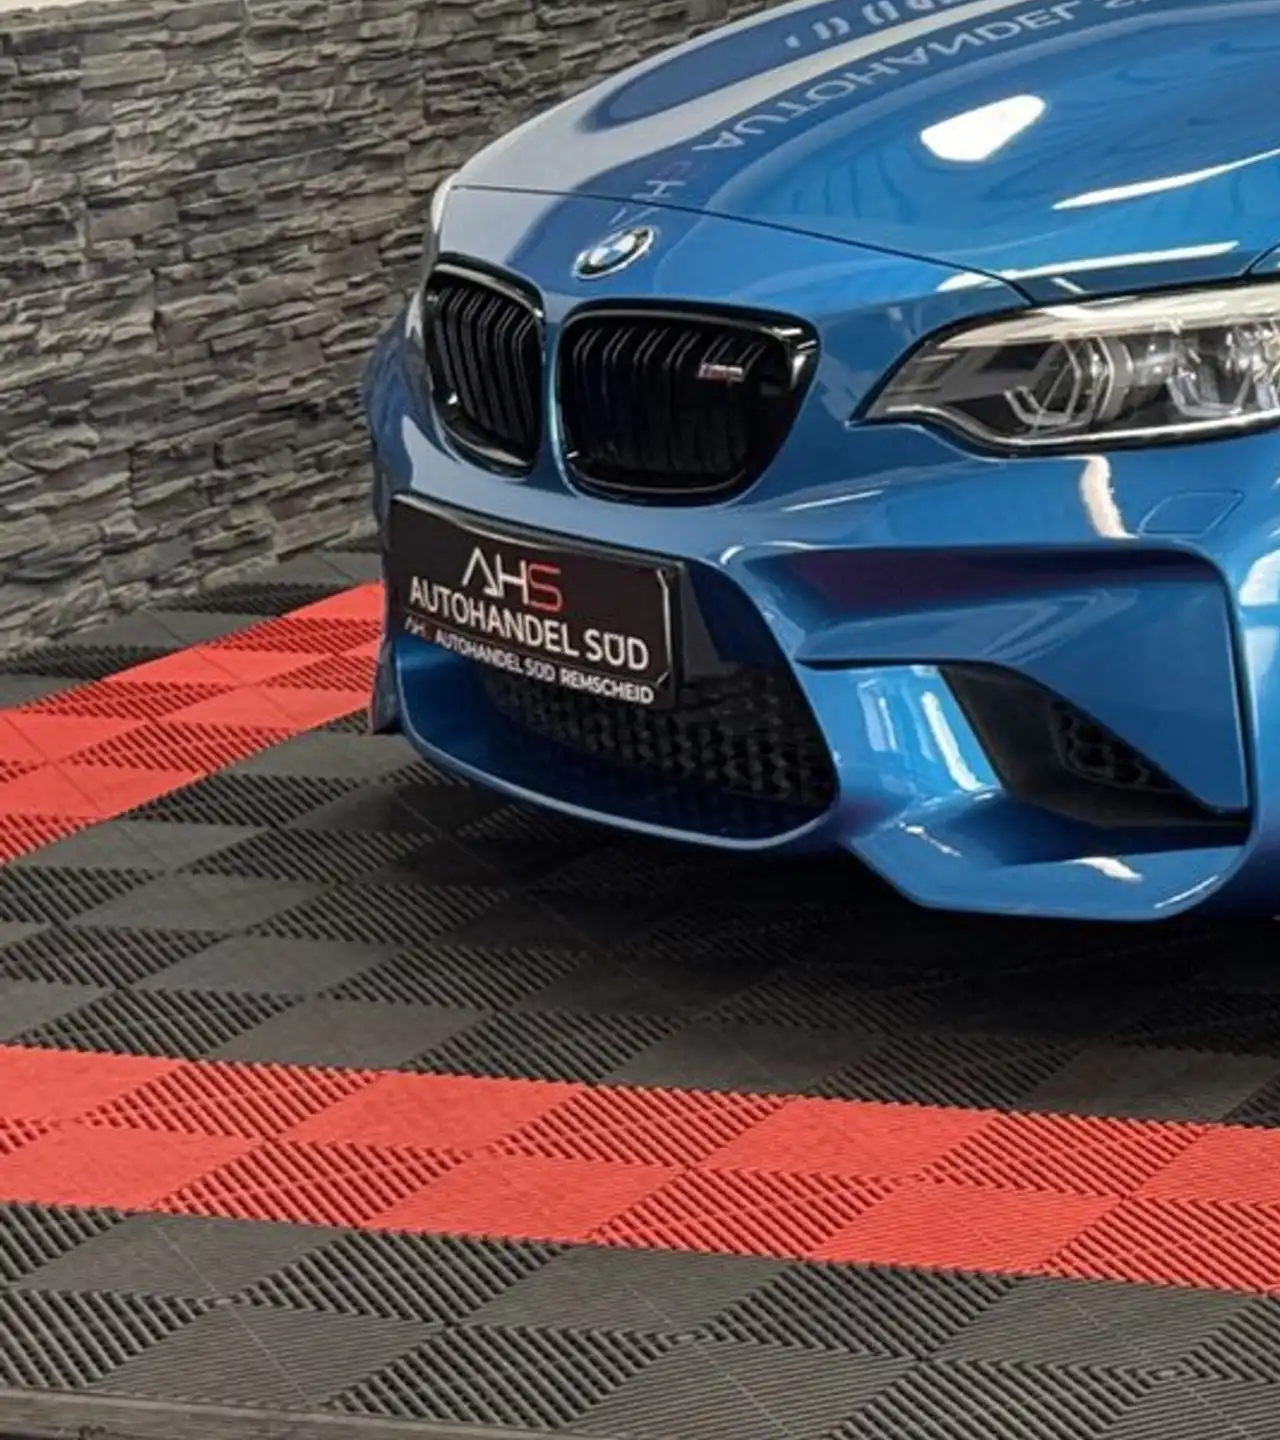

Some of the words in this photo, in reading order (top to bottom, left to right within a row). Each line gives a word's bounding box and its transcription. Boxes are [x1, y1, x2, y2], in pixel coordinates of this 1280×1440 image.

[461, 546, 562, 612] AHS
[409, 576, 580, 658] AUTOHANDEL
[584, 628, 649, 671] SÜD
[560, 667, 655, 704] REMSCHEID
